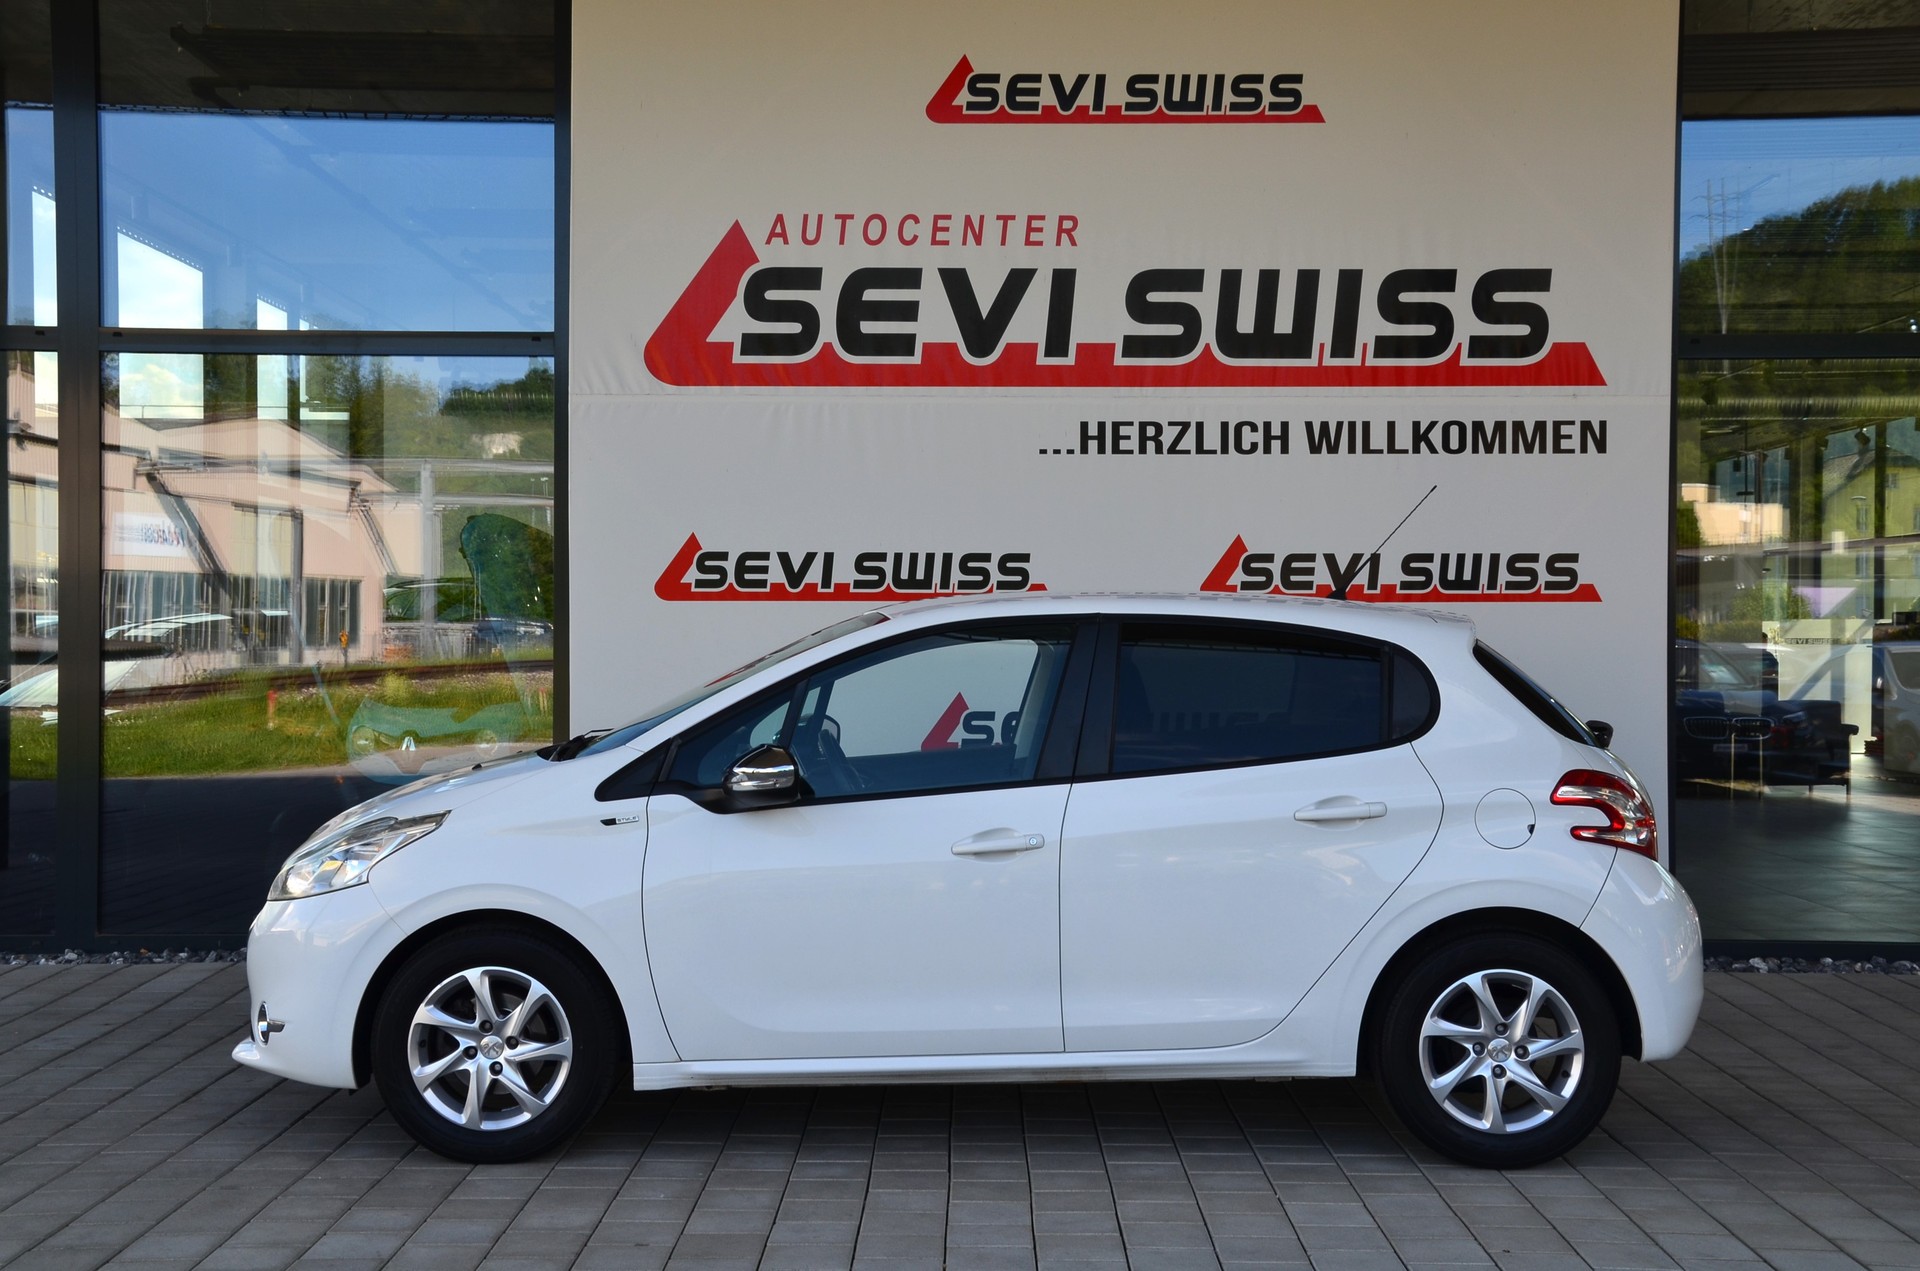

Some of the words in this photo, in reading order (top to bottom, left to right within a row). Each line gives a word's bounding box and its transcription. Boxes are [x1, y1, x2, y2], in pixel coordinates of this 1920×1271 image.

[966, 73, 1107, 112] SEVI
[1124, 73, 1304, 112] SWISS
[766, 213, 1079, 247] AUTOCENTER
[739, 266, 1077, 359] SEVI
[1121, 268, 1553, 360] SWISS
[1304, 419, 1608, 455] WILLKOMMEN
[694, 551, 835, 590] SEVI
[852, 551, 1031, 591] SWISS
[1239, 552, 1382, 592] SEVI
[1399, 552, 1580, 592] SWISS
